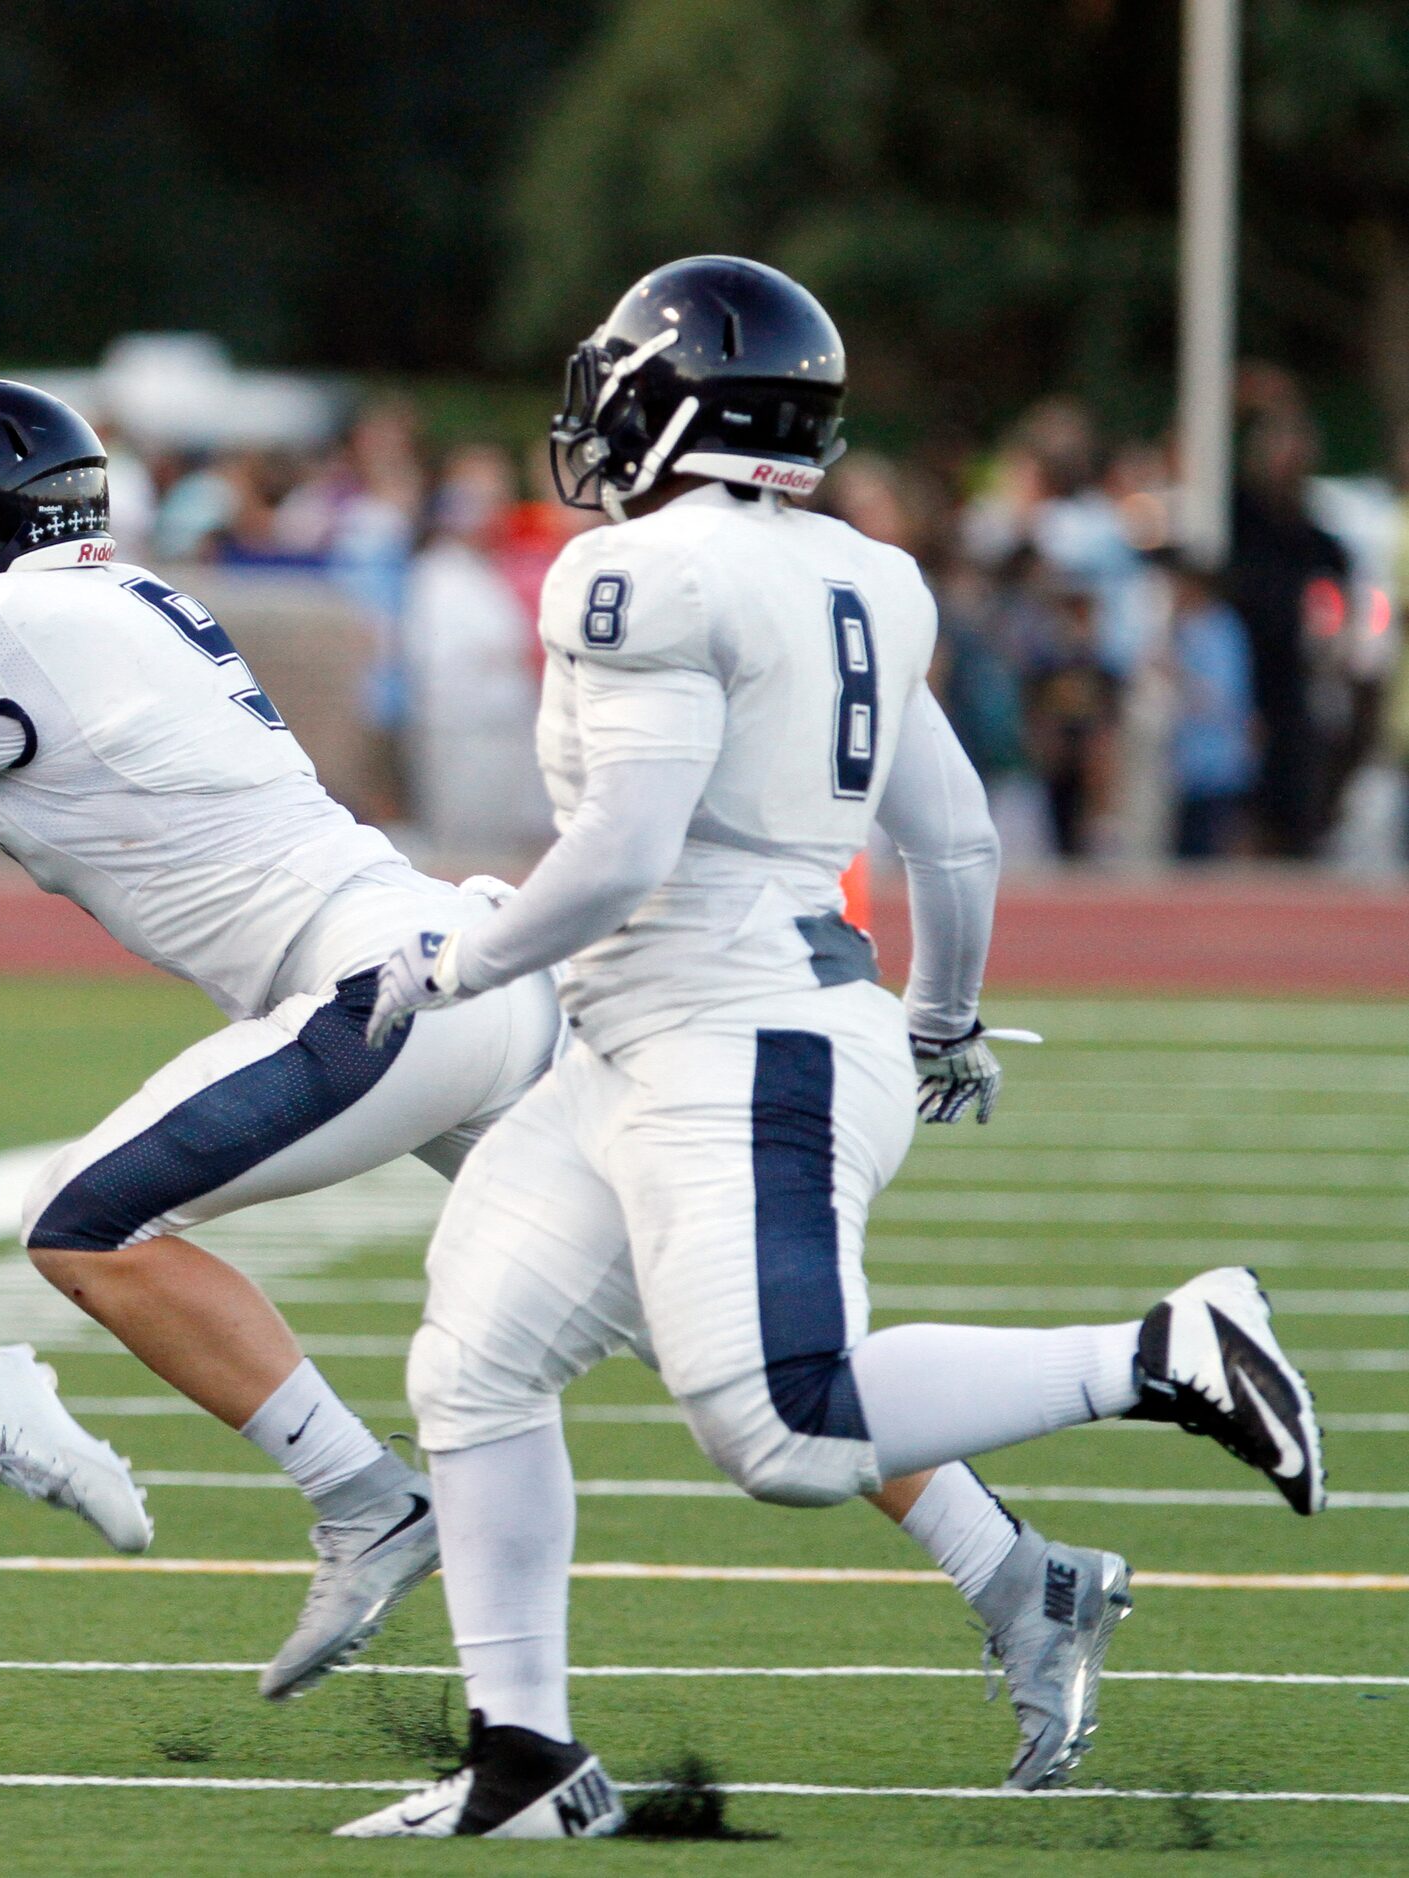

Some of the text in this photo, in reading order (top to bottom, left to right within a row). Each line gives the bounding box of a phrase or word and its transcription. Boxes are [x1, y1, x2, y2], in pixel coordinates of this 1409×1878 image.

[580, 570, 633, 650] 8
[822, 577, 881, 801] 8
[1044, 1558, 1078, 1626] NIKE
